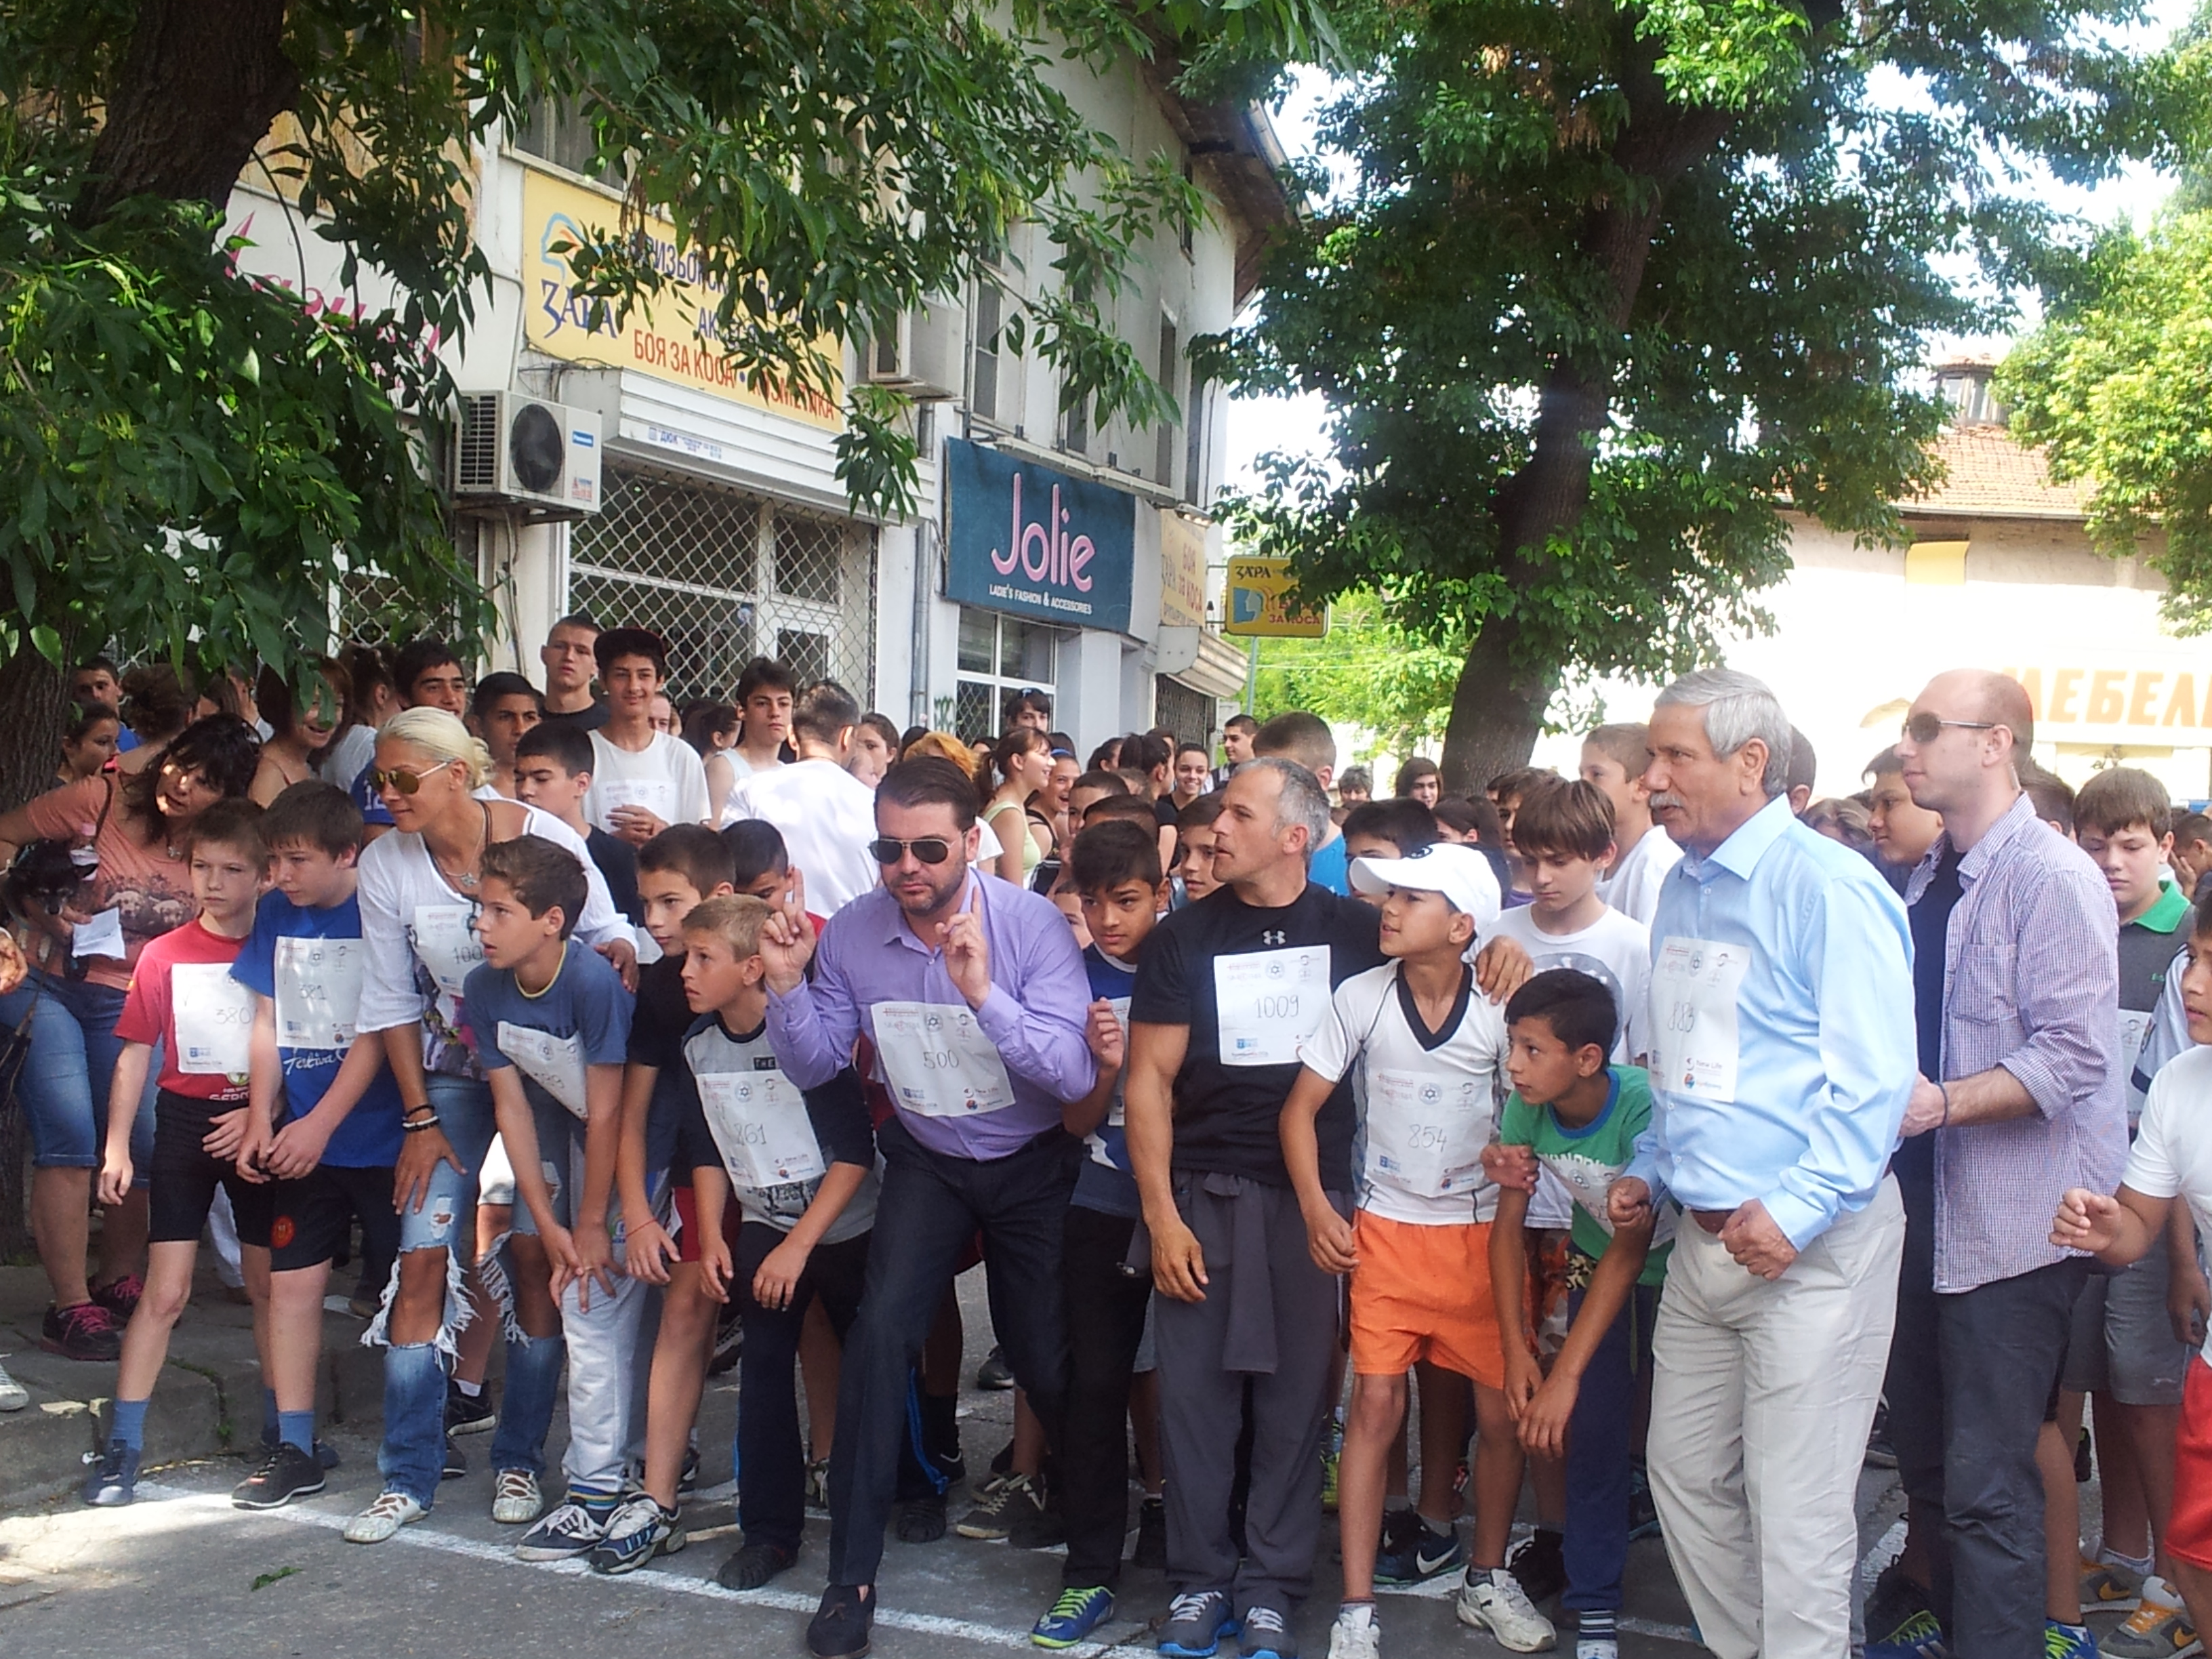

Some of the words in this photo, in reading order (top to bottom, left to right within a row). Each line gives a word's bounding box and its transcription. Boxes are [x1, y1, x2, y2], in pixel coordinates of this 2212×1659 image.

[634, 329, 666, 367] БОЯ
[670, 342, 691, 375] ЗА
[693, 349, 735, 388] КОСА
[991, 472, 1095, 592] Jolie
[1235, 565, 1271, 580] ЗАРА
[1015, 588, 1042, 605] FASHION
[1043, 591, 1050, 607] &
[1051, 596, 1092, 615] ACCESSORIES
[1269, 614, 1284, 623] ЗА
[2003, 667, 2212, 729] ЕБЕЛ
[213, 1006, 251, 1025] 380
[1254, 995, 1299, 1018] 1009
[922, 1049, 960, 1069] 500
[1407, 1124, 1447, 1153] 854
